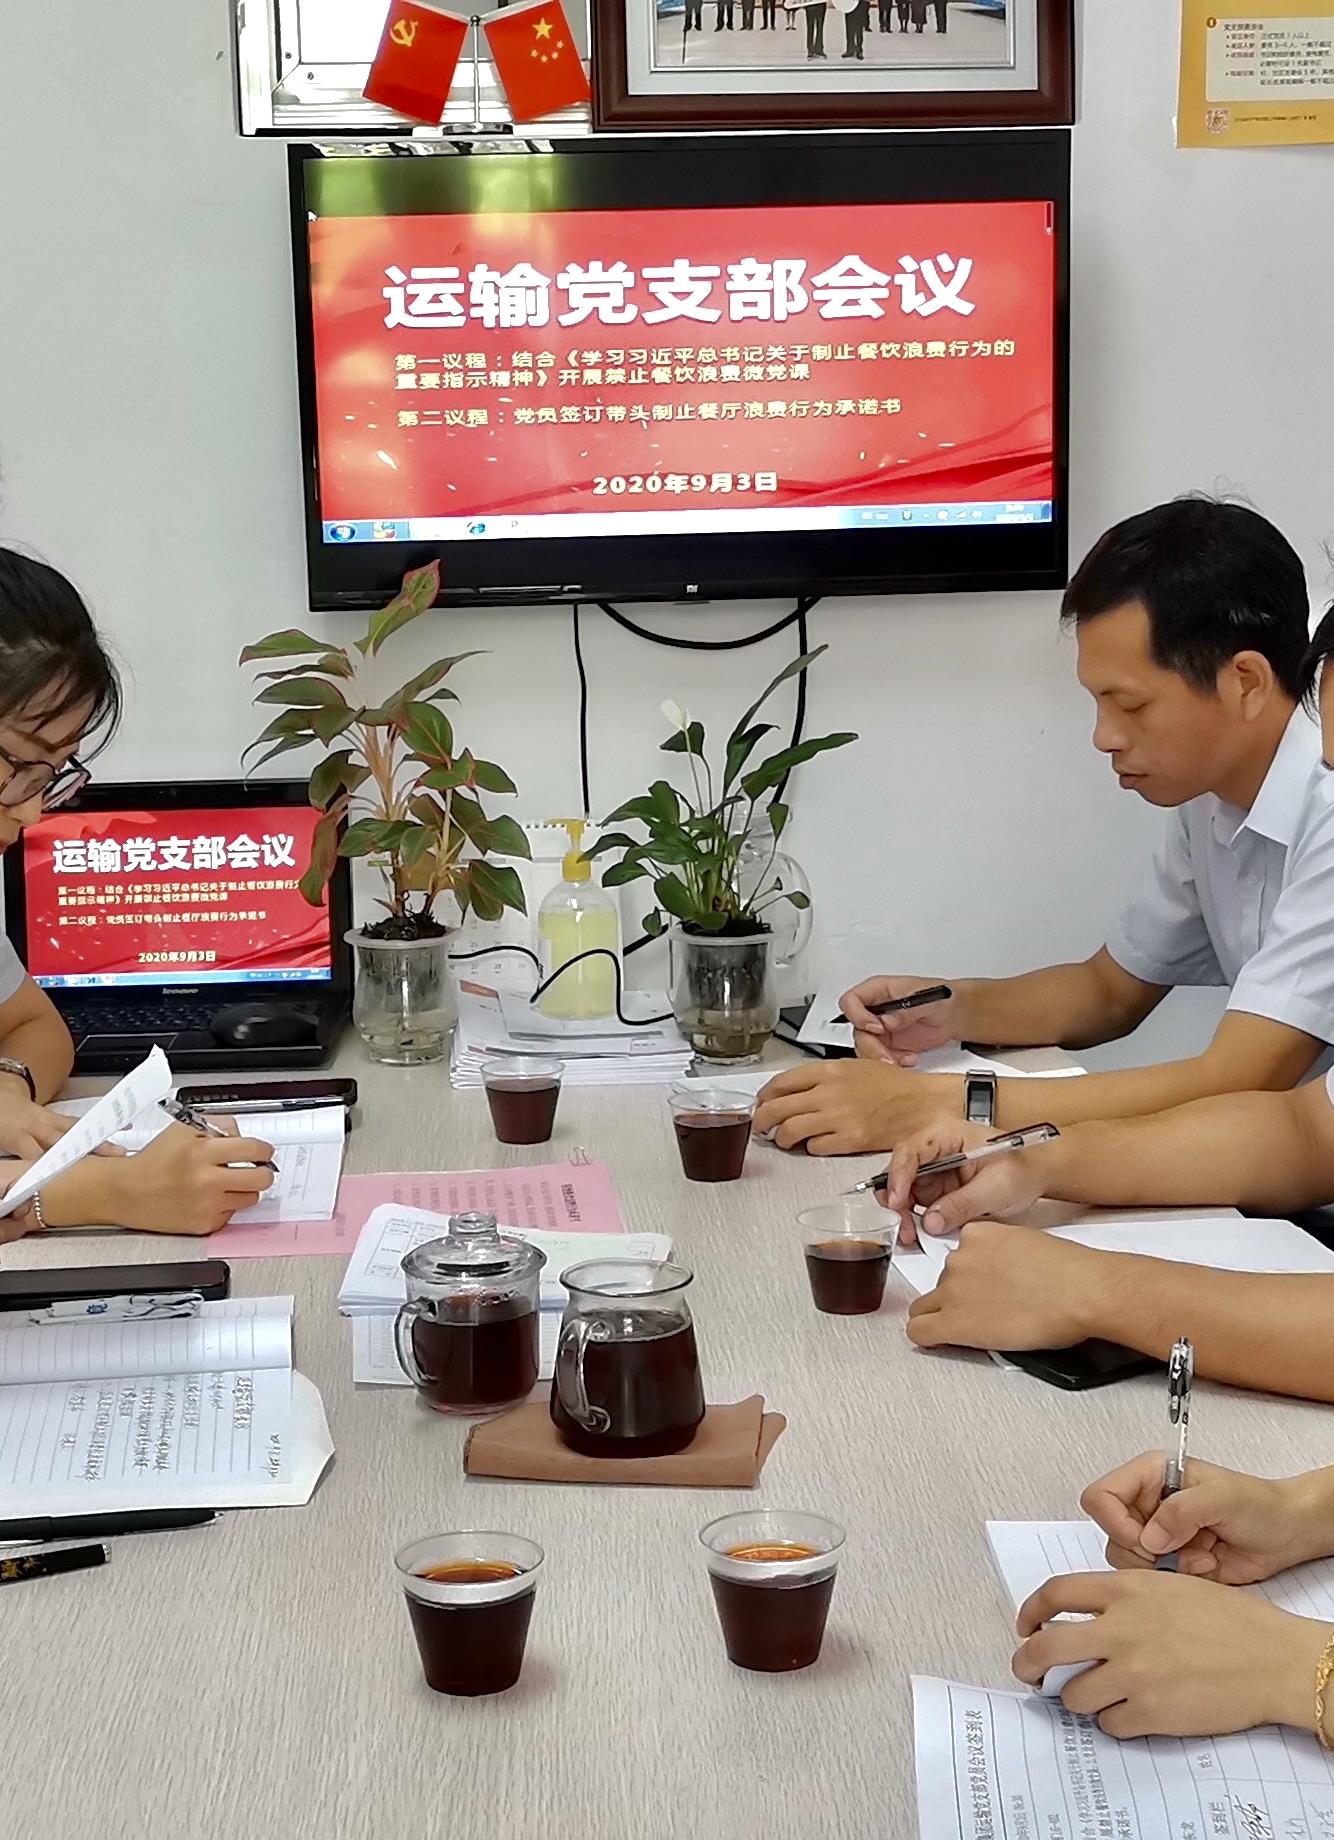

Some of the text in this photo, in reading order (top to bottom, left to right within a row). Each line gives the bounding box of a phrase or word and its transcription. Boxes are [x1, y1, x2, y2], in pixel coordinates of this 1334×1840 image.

[382, 253, 976, 330] 运输党支部会议
[397, 397, 902, 428] 第二议程：党员签订带头制止餐厅浪费行为承诺书
[592, 471, 779, 496] 2020年9月3日
[52, 833, 296, 874] 运输党支部会议
[138, 951, 216, 963] 2020年9月3日
